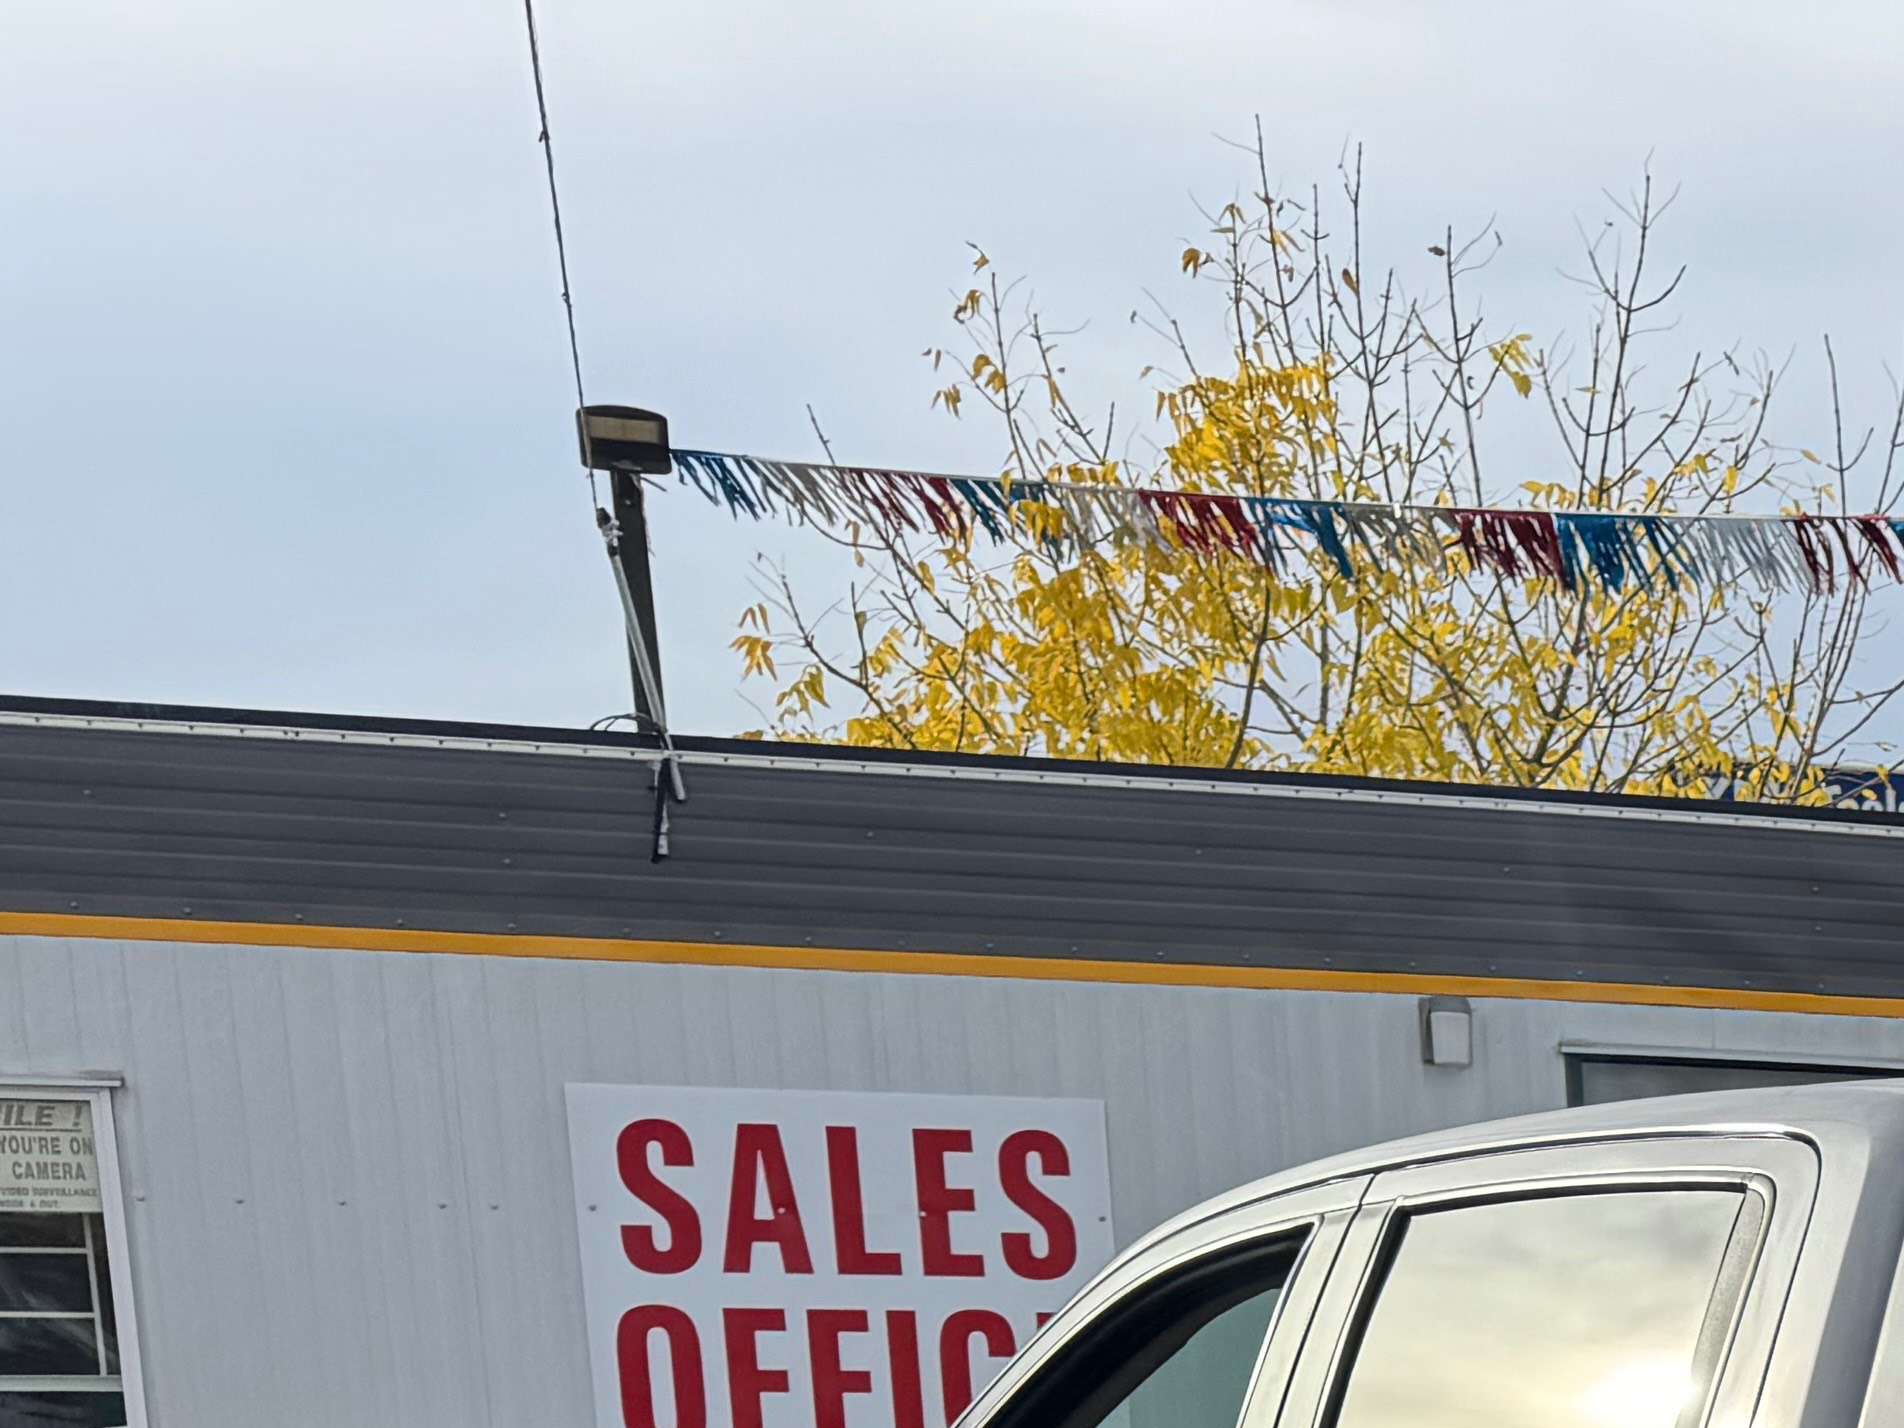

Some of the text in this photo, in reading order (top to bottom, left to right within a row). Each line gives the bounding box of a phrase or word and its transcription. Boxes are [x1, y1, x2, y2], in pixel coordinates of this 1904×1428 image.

[0, 1104, 55, 1126] ILE
[69, 1137, 93, 1155] ON
[12, 1161, 86, 1181] CAMERA
[616, 1118, 1077, 1280] SALES
